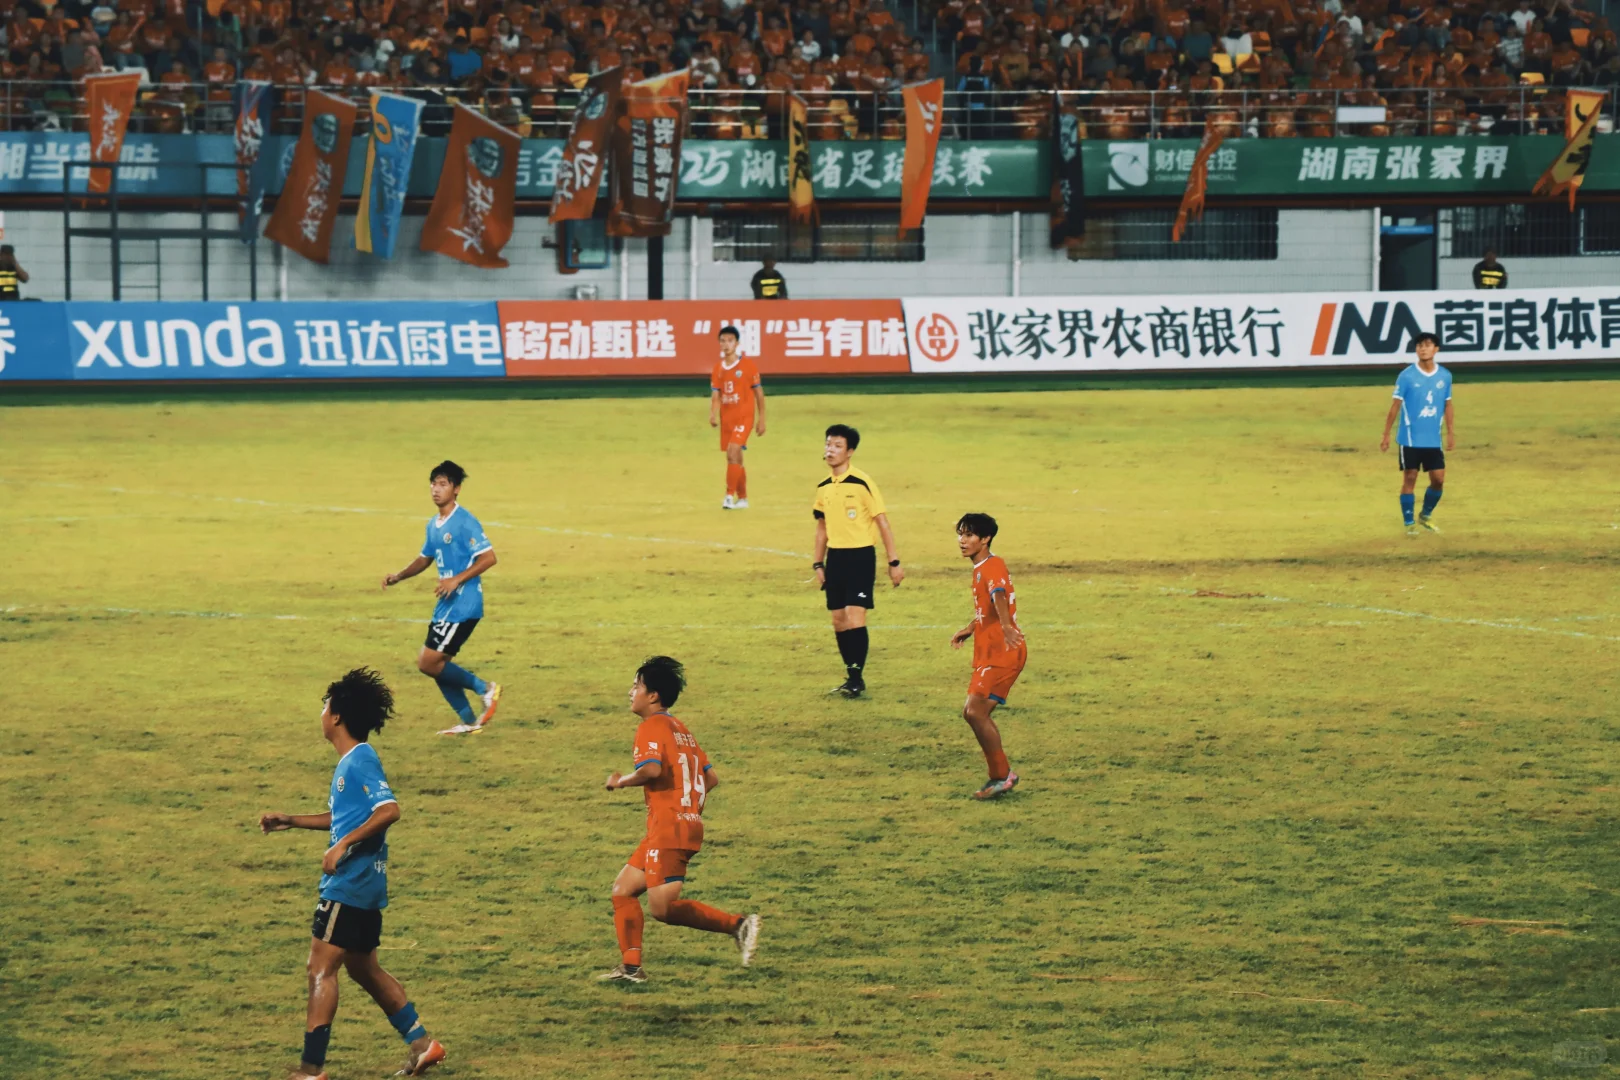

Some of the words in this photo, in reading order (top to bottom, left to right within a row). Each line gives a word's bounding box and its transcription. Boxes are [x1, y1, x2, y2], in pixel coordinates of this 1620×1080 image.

[679, 147, 732, 186] 25
[1298, 145, 1508, 181] 湖南张家界
[72, 306, 286, 368] xunda
[294, 319, 503, 366] 迅达厨电
[967, 304, 1285, 360] 张家界农商银行
[724, 381, 734, 393] 13
[432, 618, 450, 637] 21
[677, 752, 706, 808] 14
[645, 849, 659, 863] 14
